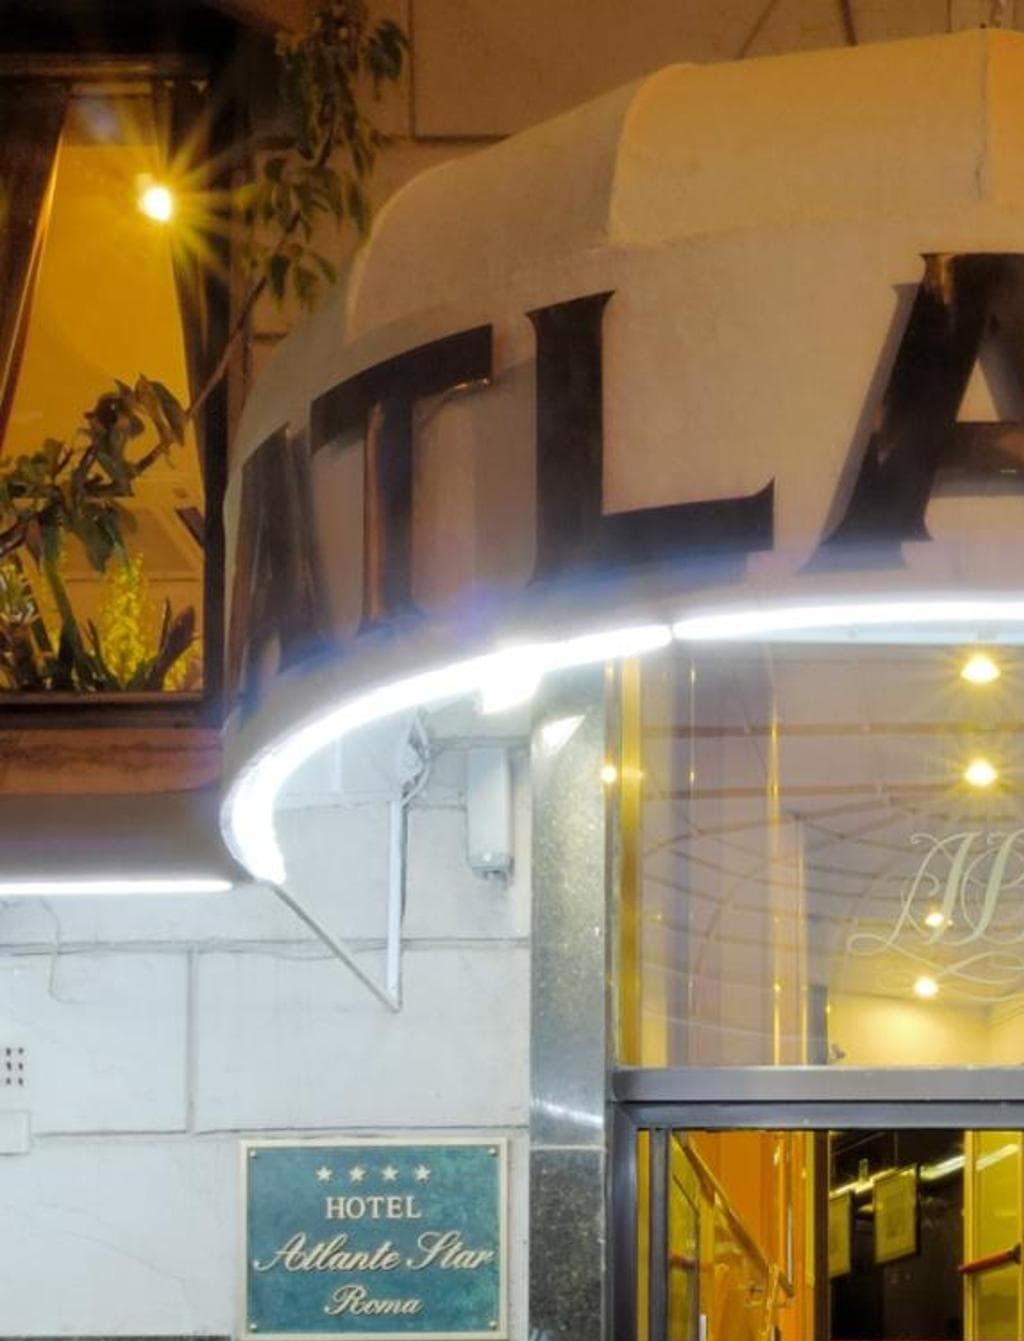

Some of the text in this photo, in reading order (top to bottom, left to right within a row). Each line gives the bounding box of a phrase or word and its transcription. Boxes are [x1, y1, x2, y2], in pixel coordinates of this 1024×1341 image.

[325, 1197, 422, 1220] HOTEL
[253, 1231, 494, 1272] Atlante Star
[323, 1285, 423, 1316] Roma
